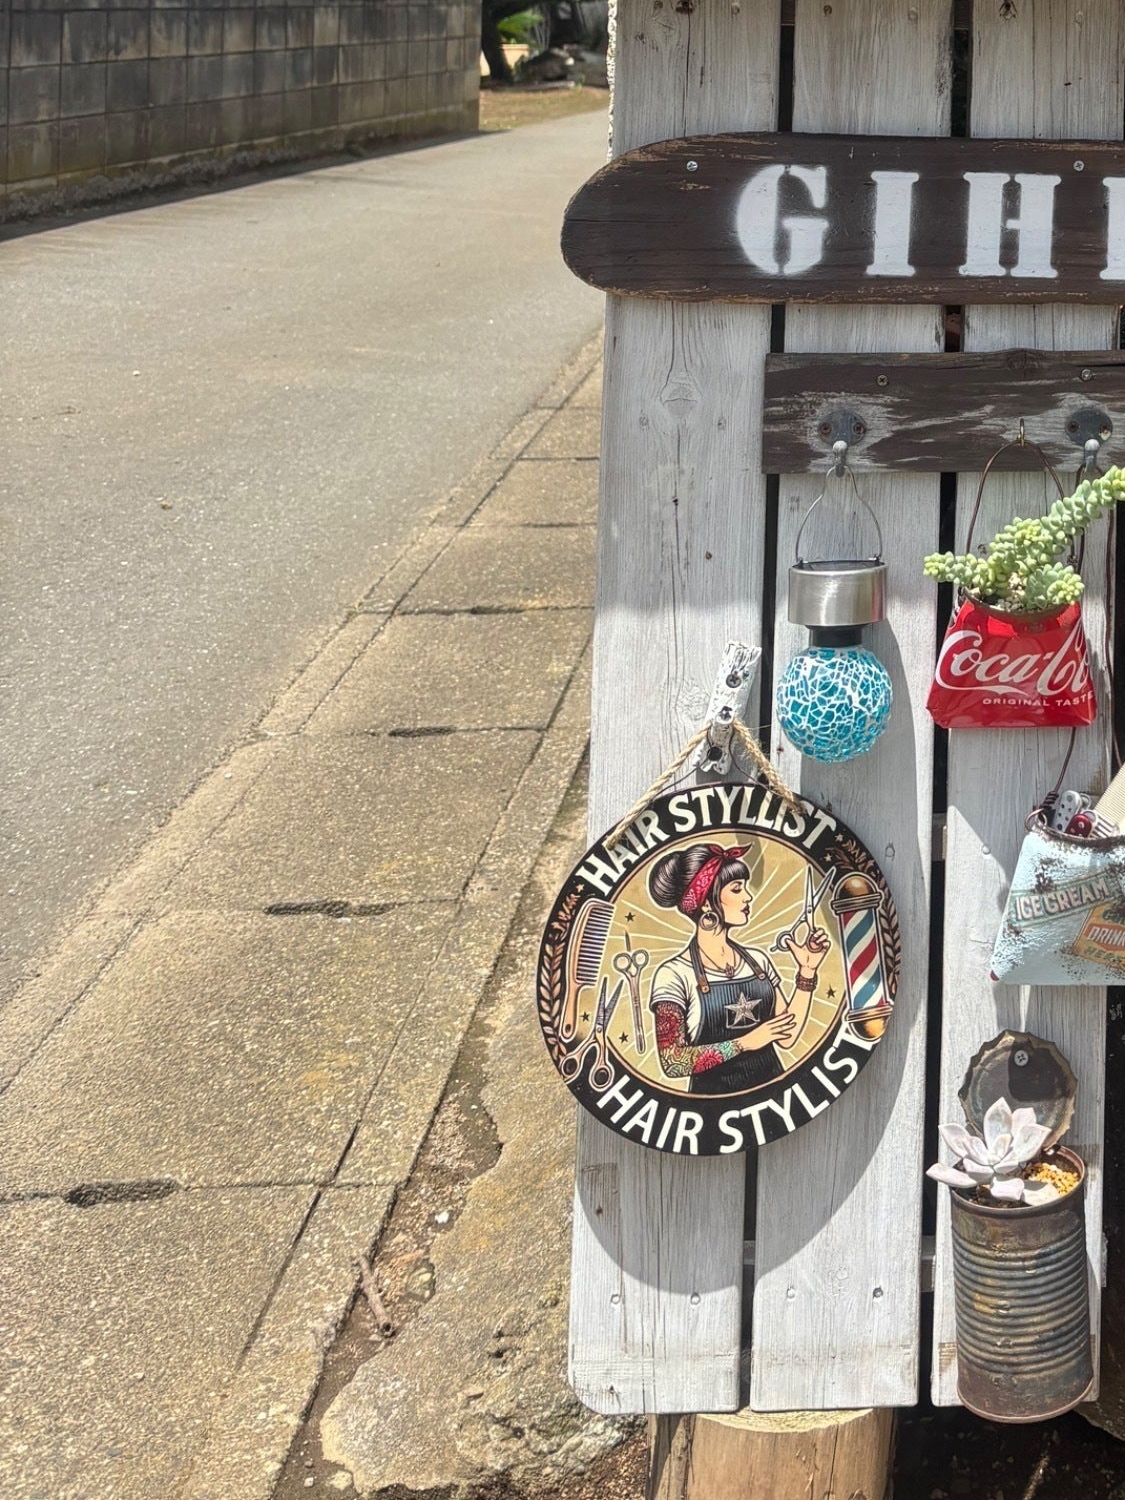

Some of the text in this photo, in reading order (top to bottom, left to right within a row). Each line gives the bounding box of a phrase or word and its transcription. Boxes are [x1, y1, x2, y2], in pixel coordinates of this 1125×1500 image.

[982, 697, 1051, 707] ORIGINAL
[575, 785, 837, 897] HAIR STYLLIST
[1014, 877, 1111, 921] ICE CREAM
[597, 1020, 873, 1155] HAIR STYLIST
